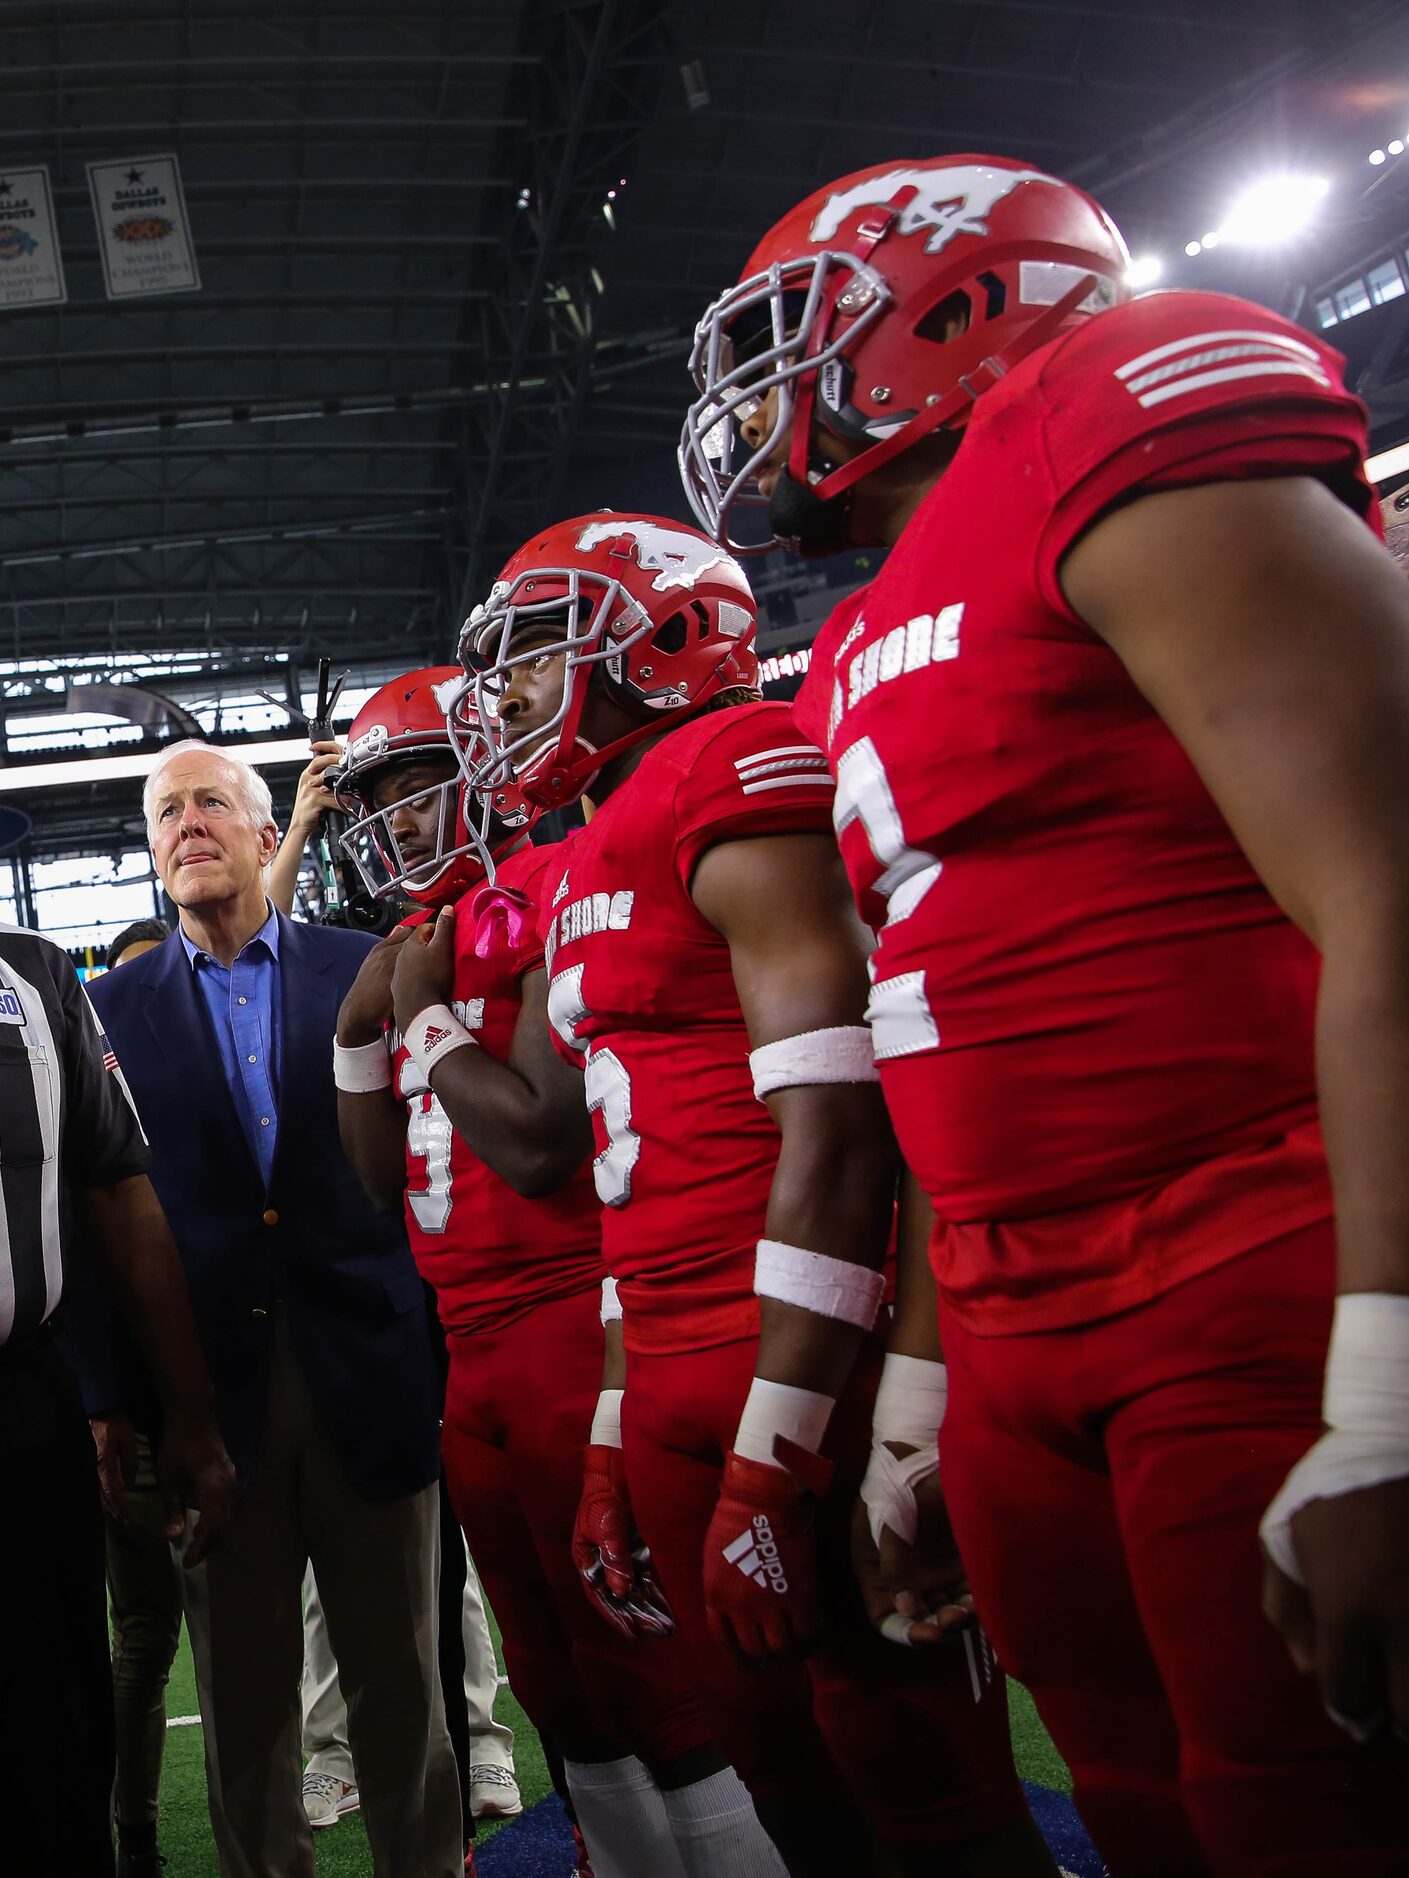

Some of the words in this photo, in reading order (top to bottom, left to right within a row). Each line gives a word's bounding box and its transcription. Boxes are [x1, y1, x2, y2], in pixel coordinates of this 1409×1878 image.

[112, 196, 167, 211] COWBOYS
[114, 187, 160, 200] DALLAS
[847, 601, 966, 710] SHORE
[560, 890, 635, 948] SHORE
[423, 1028, 453, 1054] adidas
[752, 1513, 789, 1594] adidas
